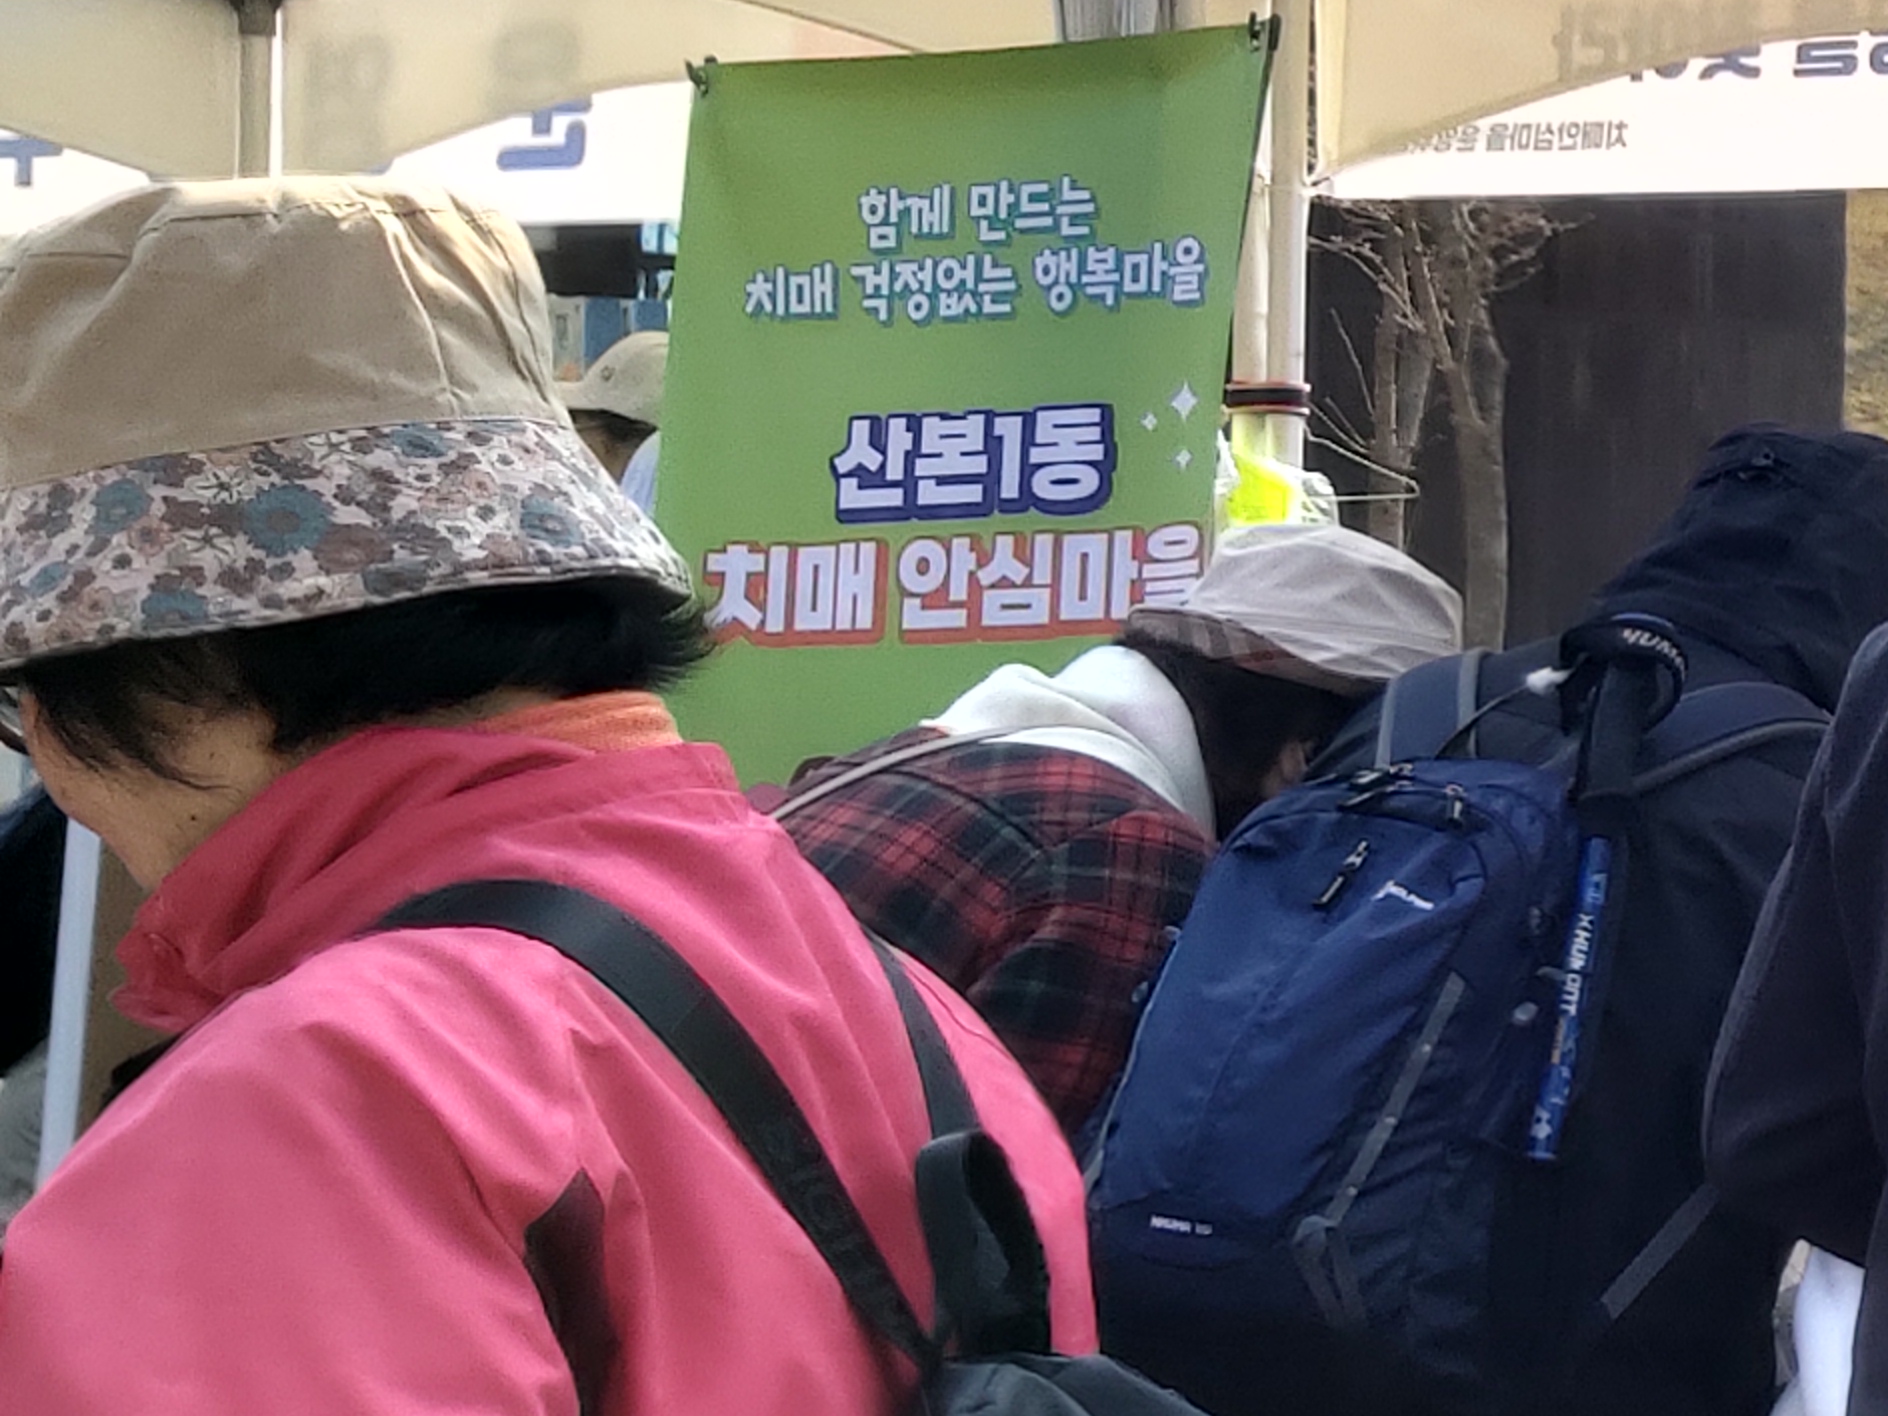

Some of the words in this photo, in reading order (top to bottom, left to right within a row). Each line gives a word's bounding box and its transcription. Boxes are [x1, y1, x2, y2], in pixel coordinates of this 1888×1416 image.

[859, 185, 952, 248] 함께
[967, 177, 1098, 243] 만드는
[744, 262, 837, 320] 치매
[850, 255, 1017, 323] 걱정없는
[1033, 236, 1207, 313] 행복마을
[833, 404, 1114, 521] 산본1동
[704, 540, 879, 641] 치매
[898, 525, 1203, 633] 안심마을
